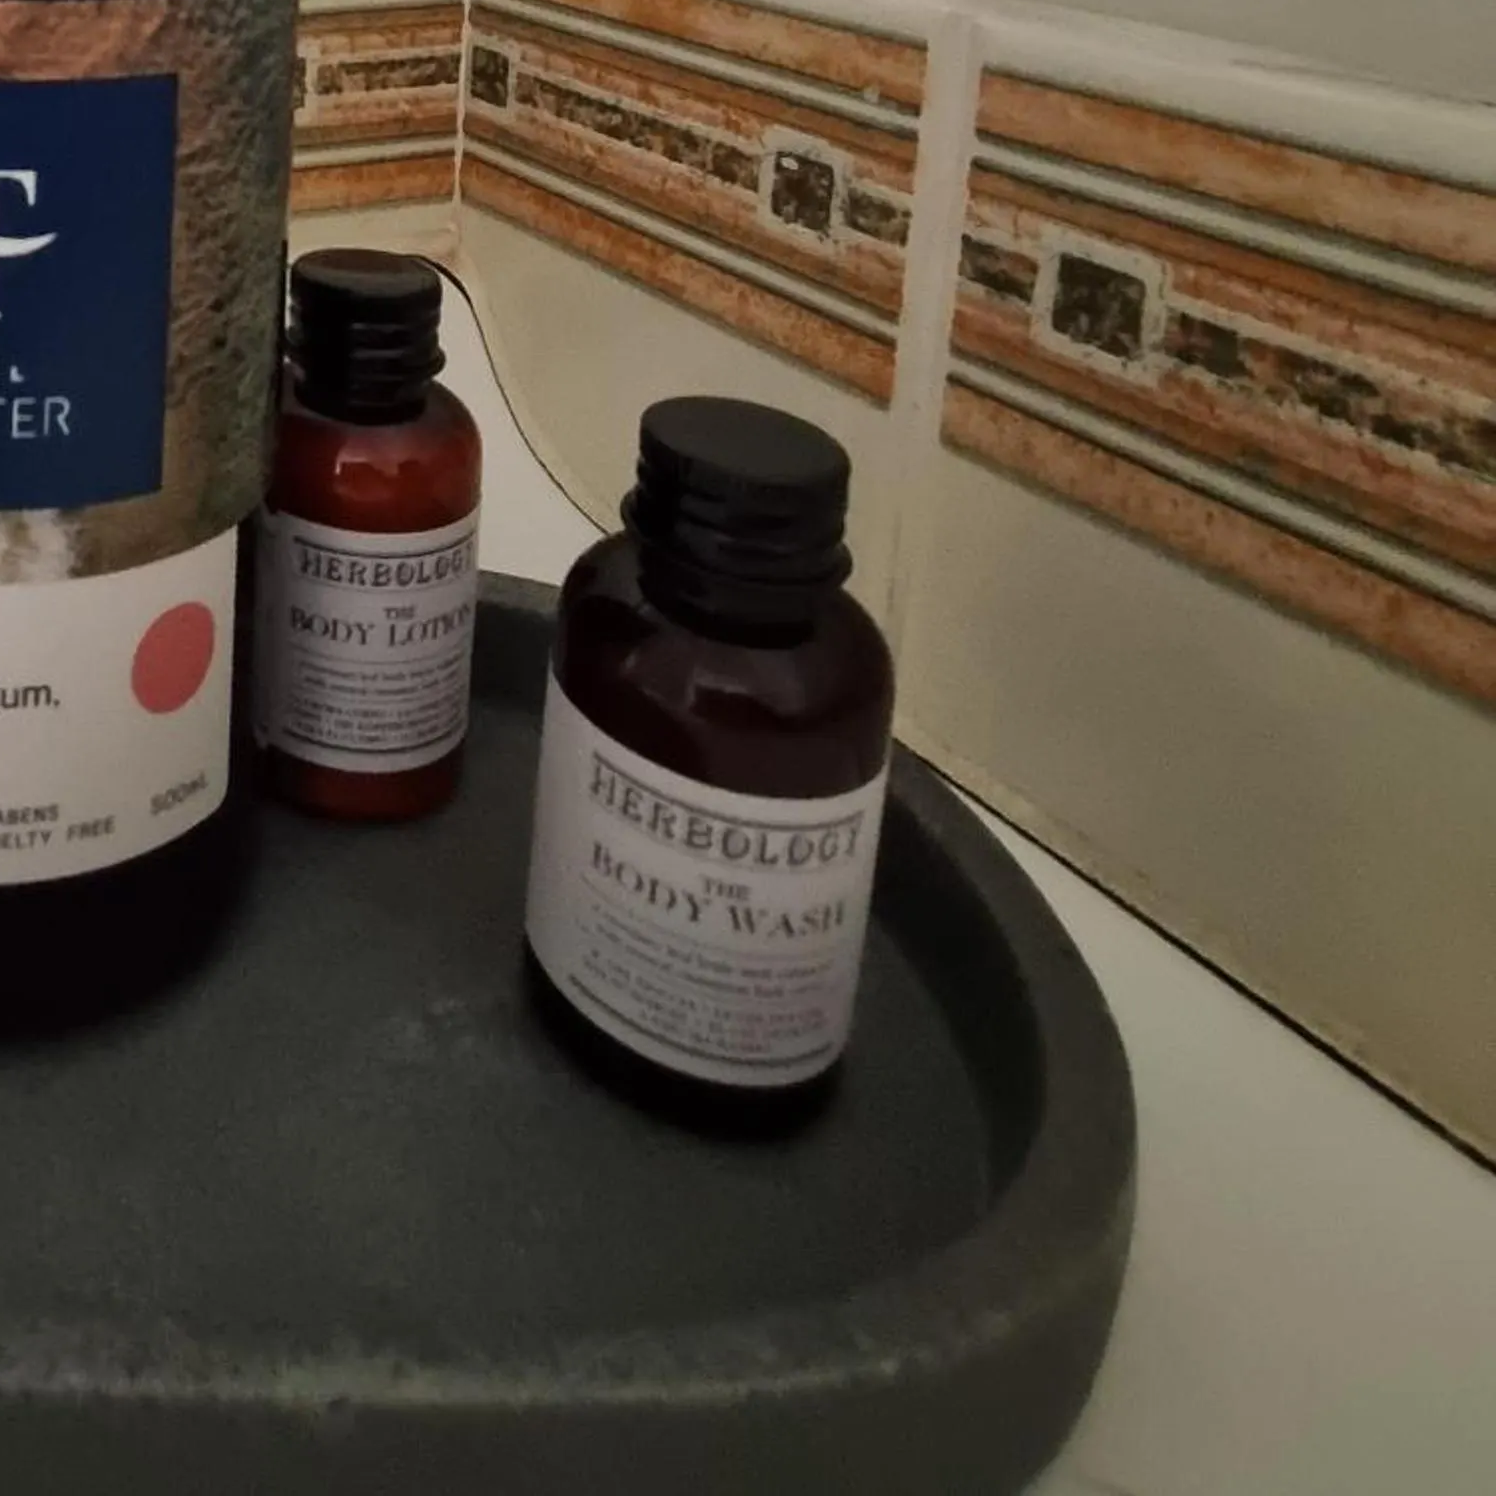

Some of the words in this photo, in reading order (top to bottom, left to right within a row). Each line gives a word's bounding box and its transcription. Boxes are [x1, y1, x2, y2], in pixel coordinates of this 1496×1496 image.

[291, 606, 375, 646] BODY
[384, 607, 415, 620] THE
[65, 815, 116, 842] FREE
[589, 760, 860, 867] HERBOLOGY
[591, 838, 710, 923] BODY
[727, 900, 844, 938] WASH
[702, 875, 752, 901] THE
